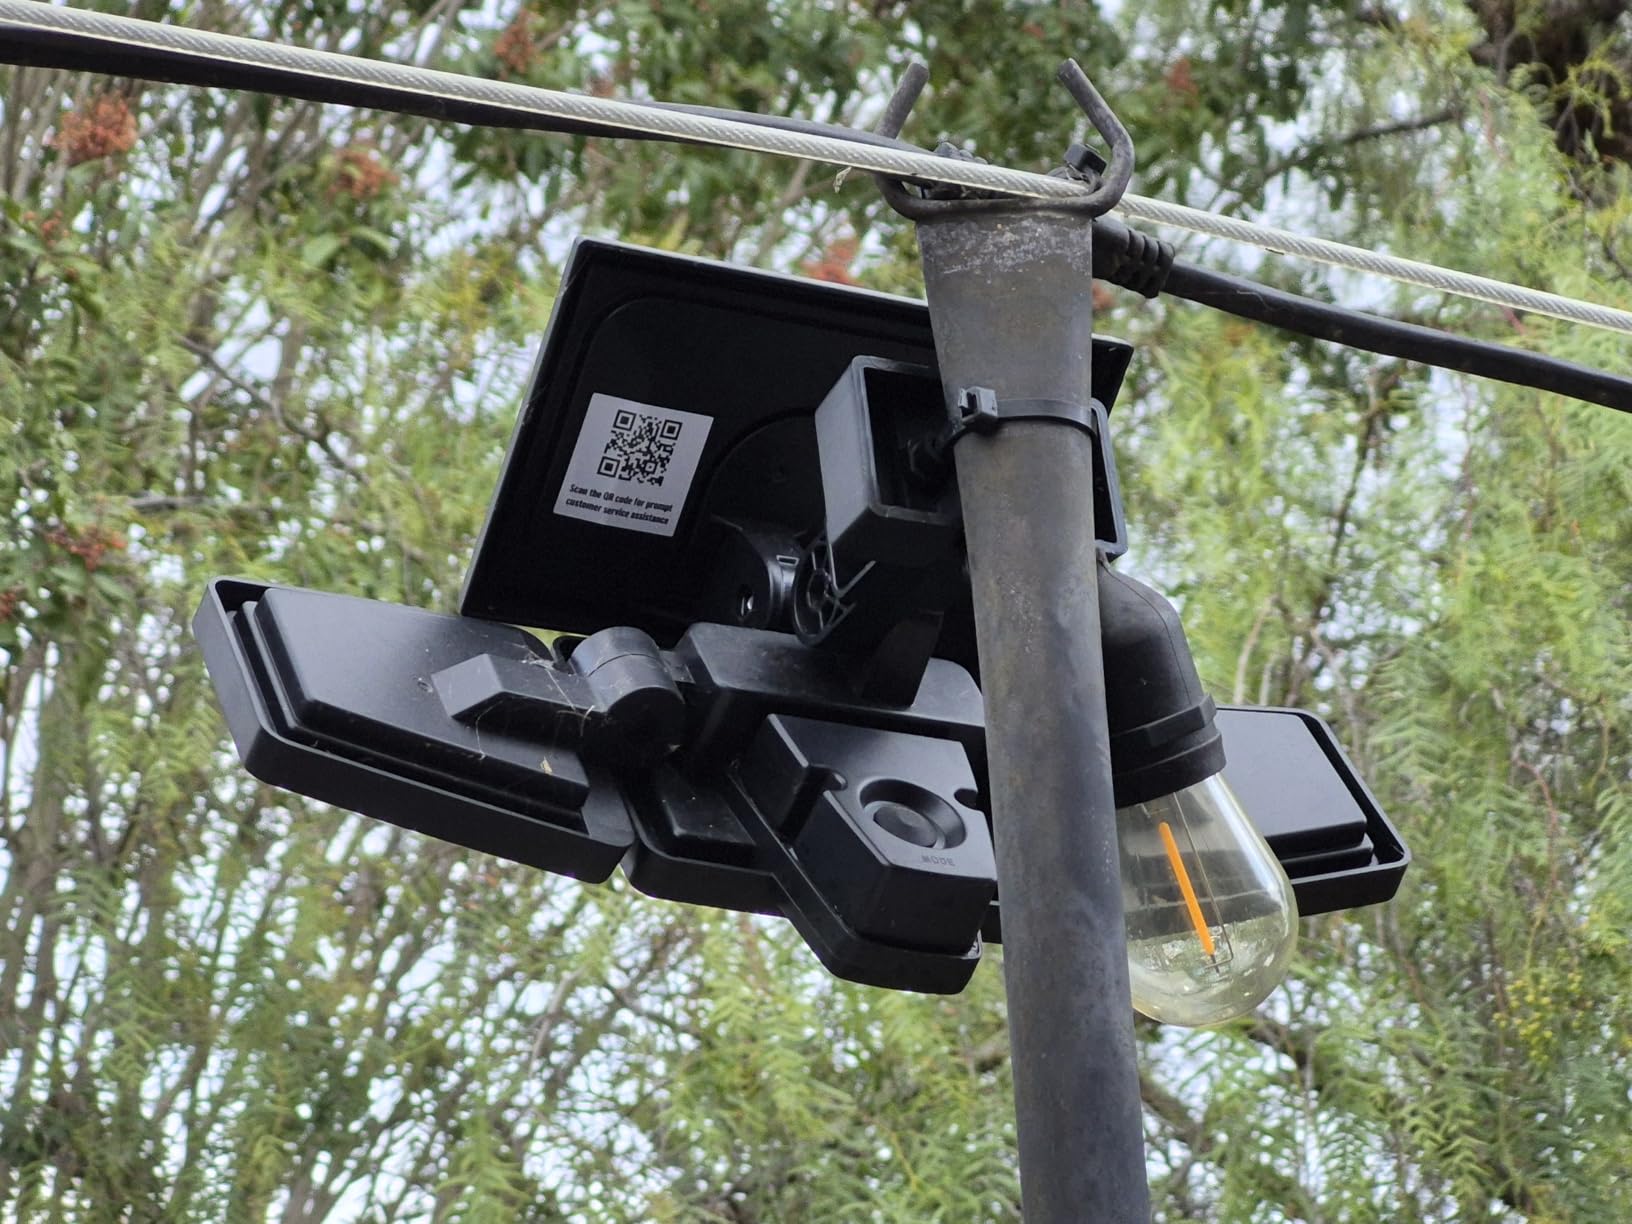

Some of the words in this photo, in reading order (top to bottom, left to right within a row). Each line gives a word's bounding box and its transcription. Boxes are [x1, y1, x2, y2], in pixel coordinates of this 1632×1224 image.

[565, 498, 602, 512] customer
[603, 506, 629, 517] service
[630, 512, 669, 524] assistance
[570, 484, 588, 495] Scan
[589, 488, 602, 499] the
[603, 491, 615, 501] QR
[615, 494, 632, 505] code
[633, 497, 645, 507] for
[645, 501, 673, 512] prompt
